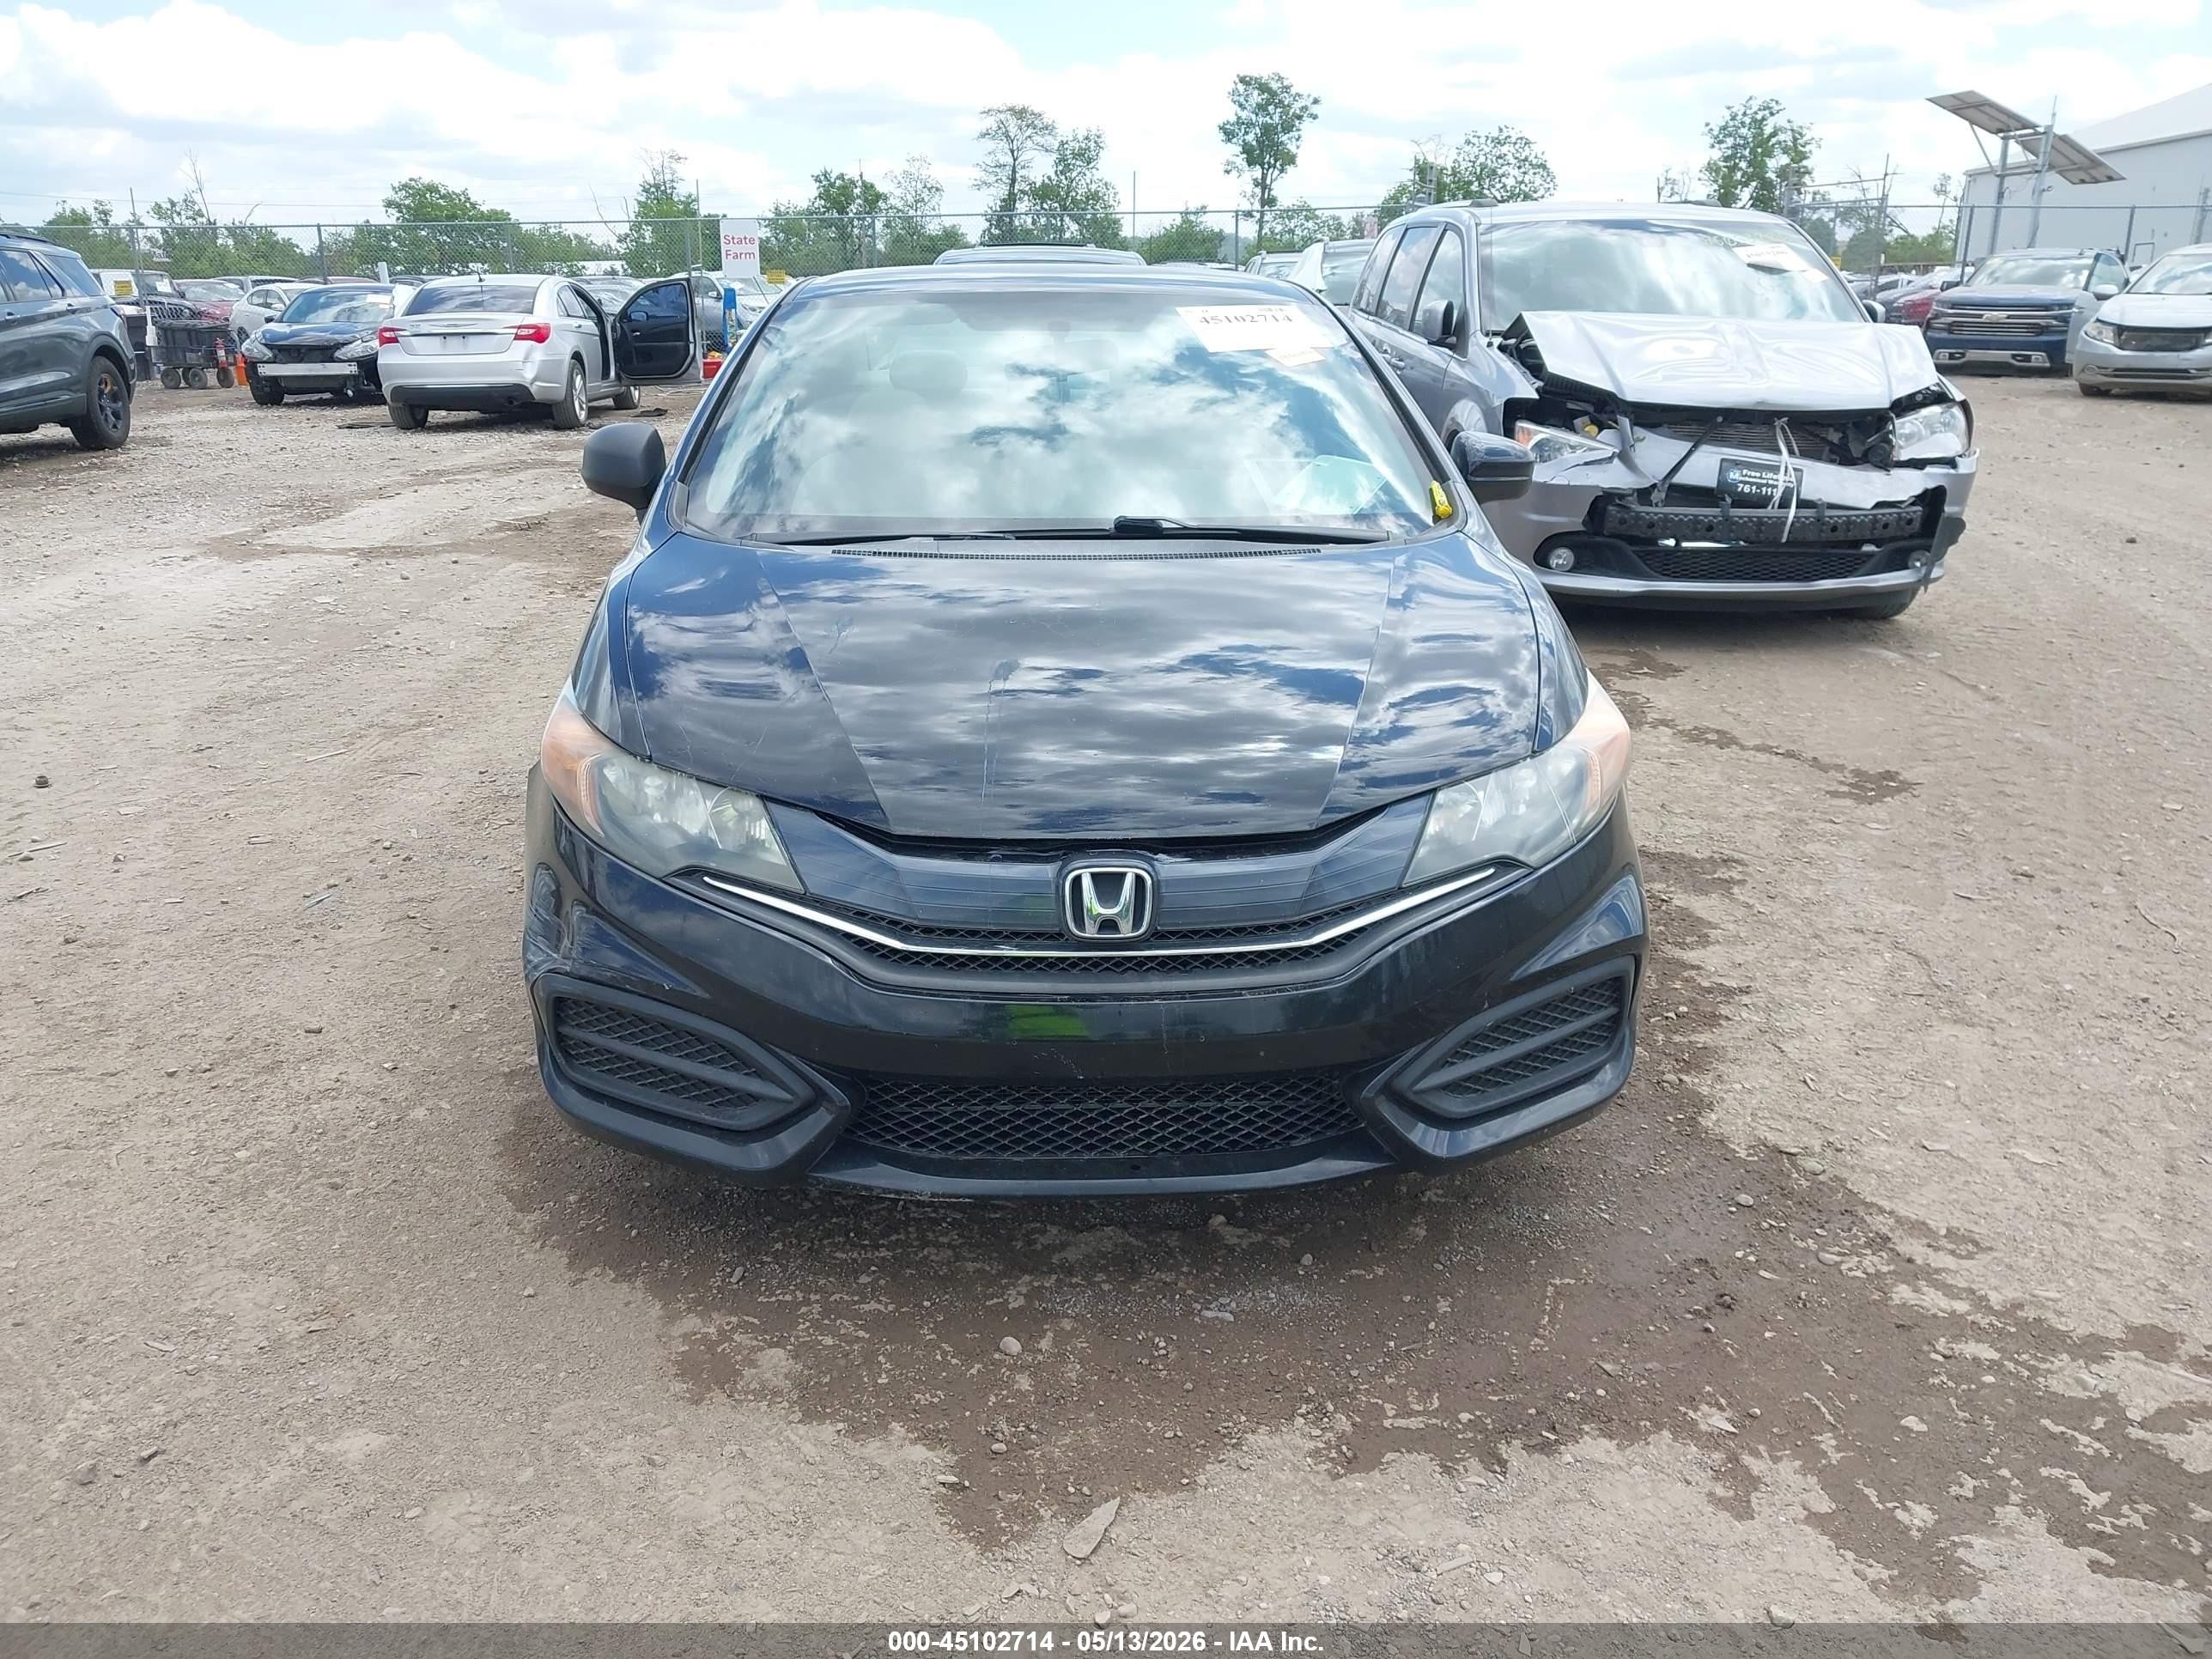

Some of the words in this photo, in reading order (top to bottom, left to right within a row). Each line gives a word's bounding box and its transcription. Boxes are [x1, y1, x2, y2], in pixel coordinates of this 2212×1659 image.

[723, 234, 756, 246] State
[725, 249, 756, 260] Farm
[1200, 314, 1293, 325] 45102714
[1737, 483, 1778, 495] 761-111
